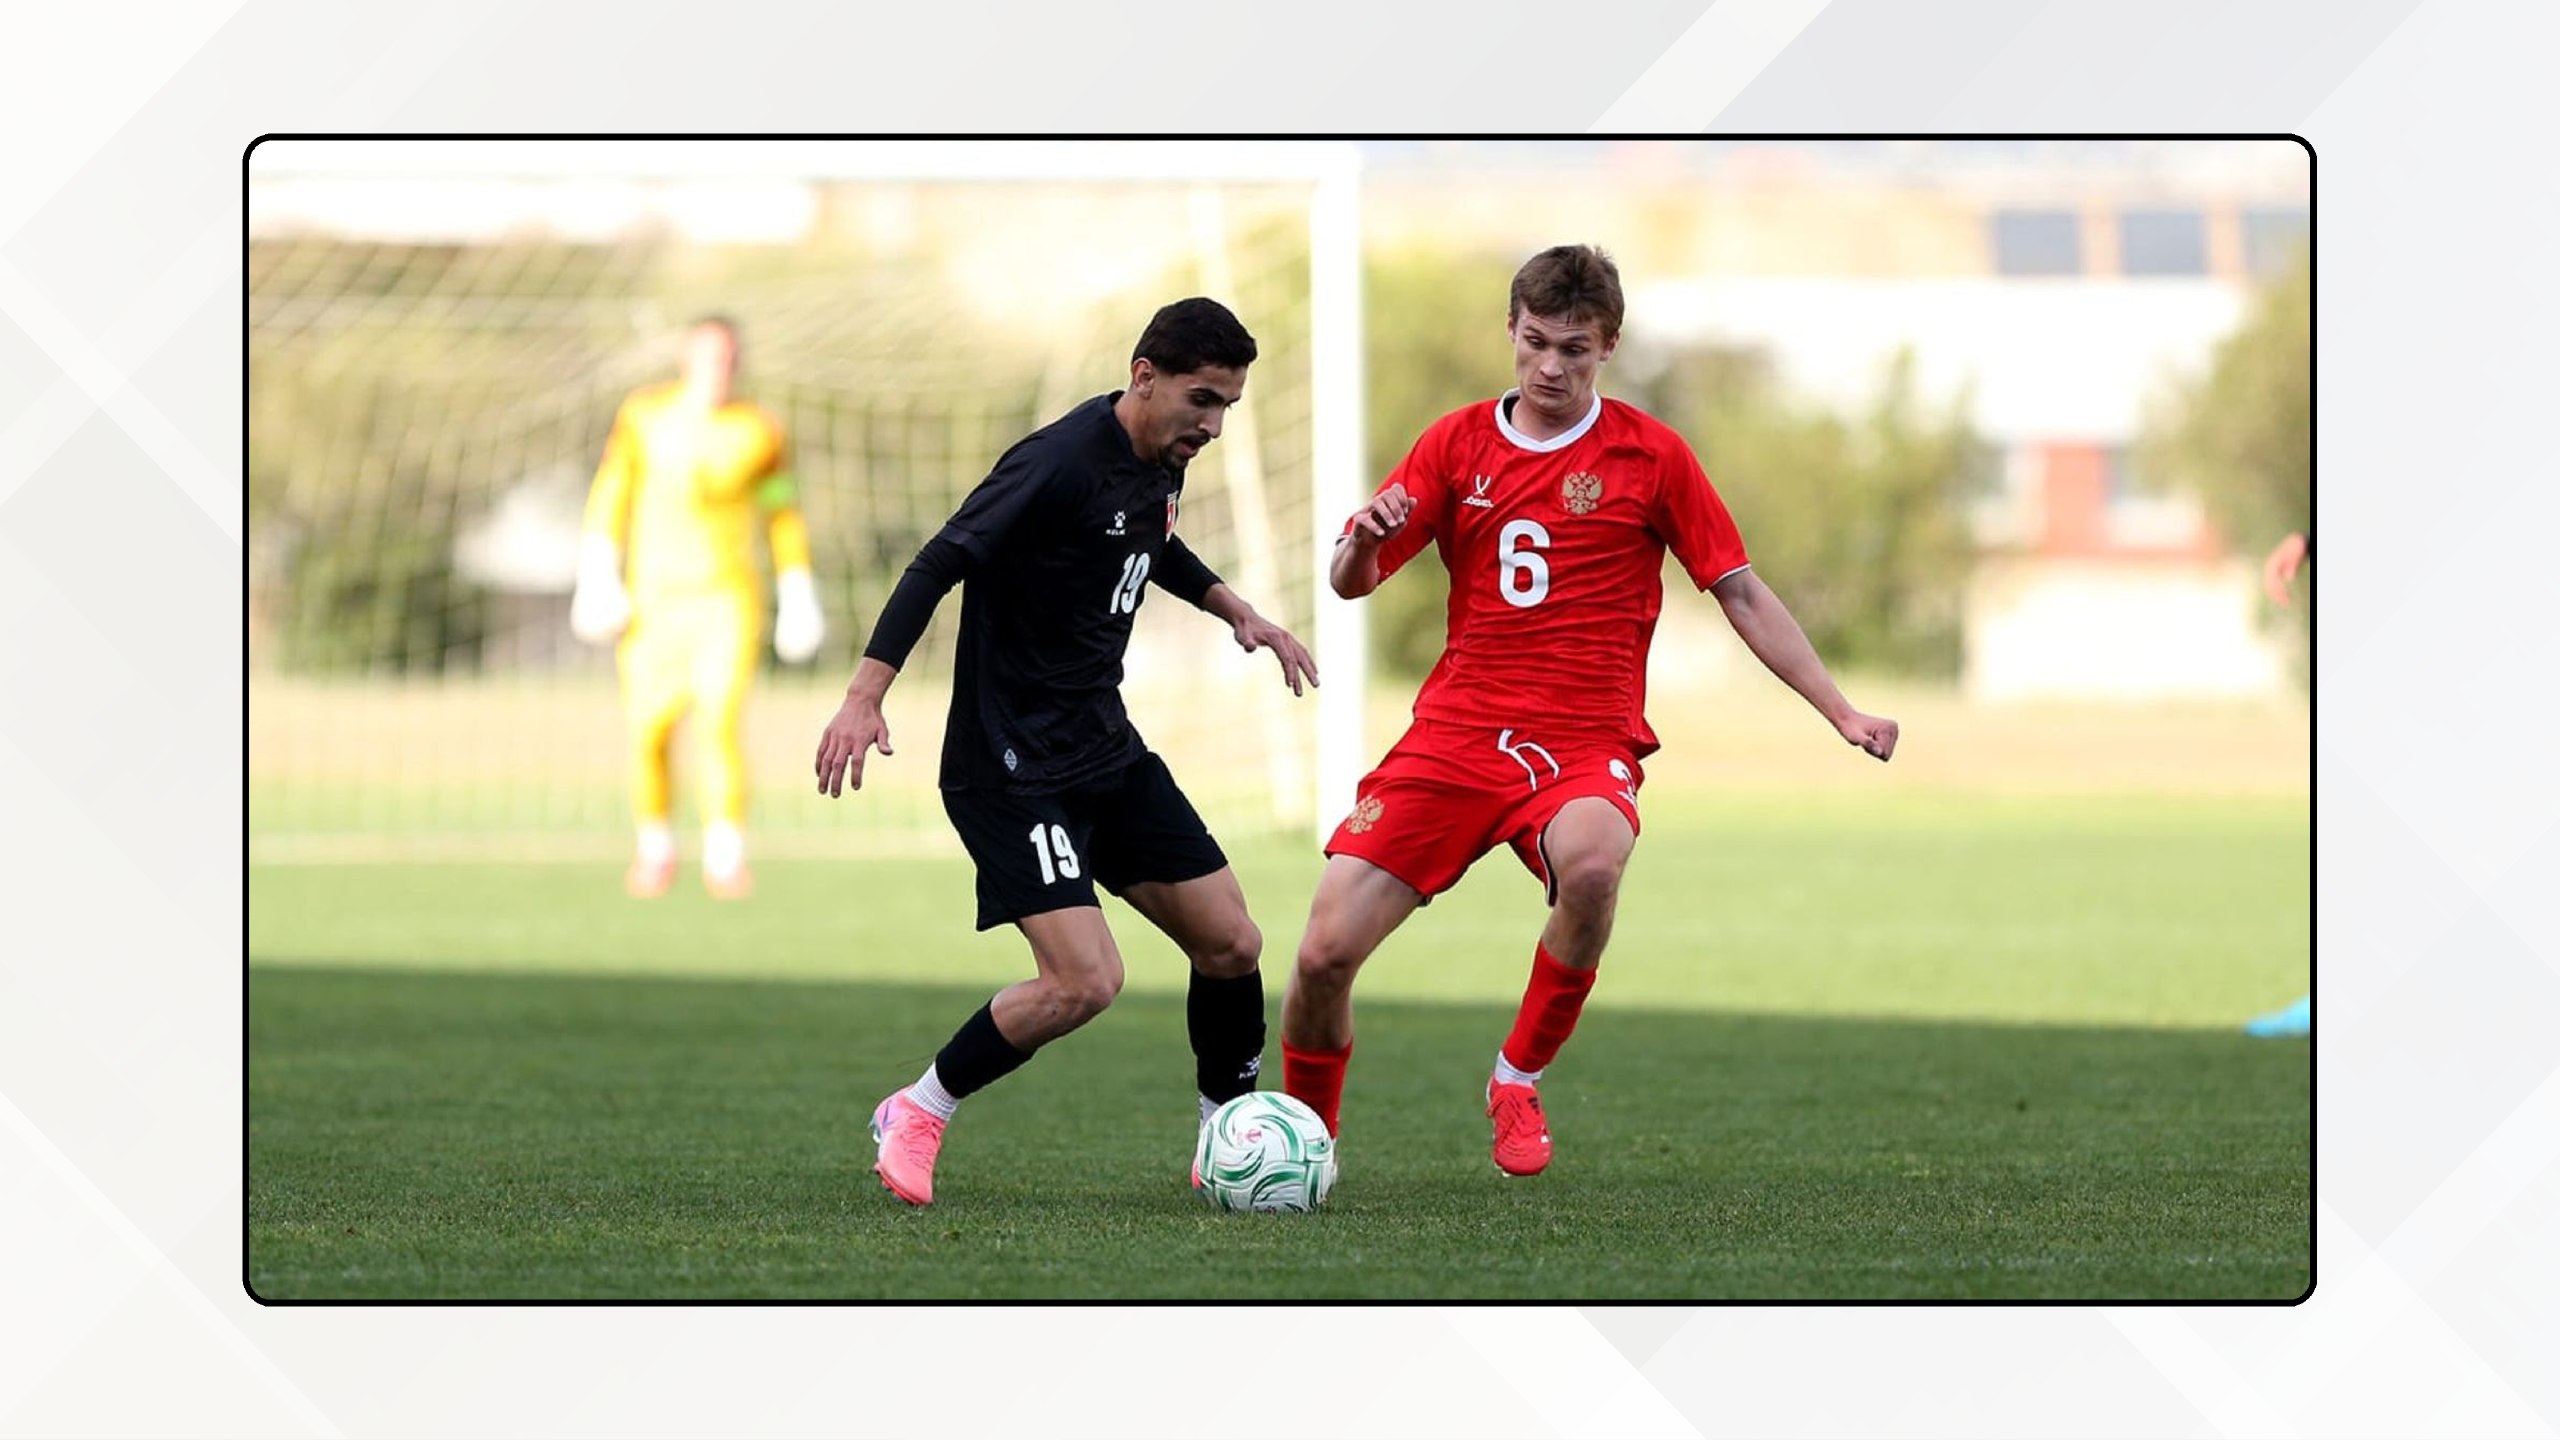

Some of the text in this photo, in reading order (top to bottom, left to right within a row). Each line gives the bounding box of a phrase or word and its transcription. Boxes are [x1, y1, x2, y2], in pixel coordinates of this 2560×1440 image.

[1109, 552, 1151, 614] 19
[1498, 519, 1550, 608] 6
[1029, 823, 1081, 885] 19
